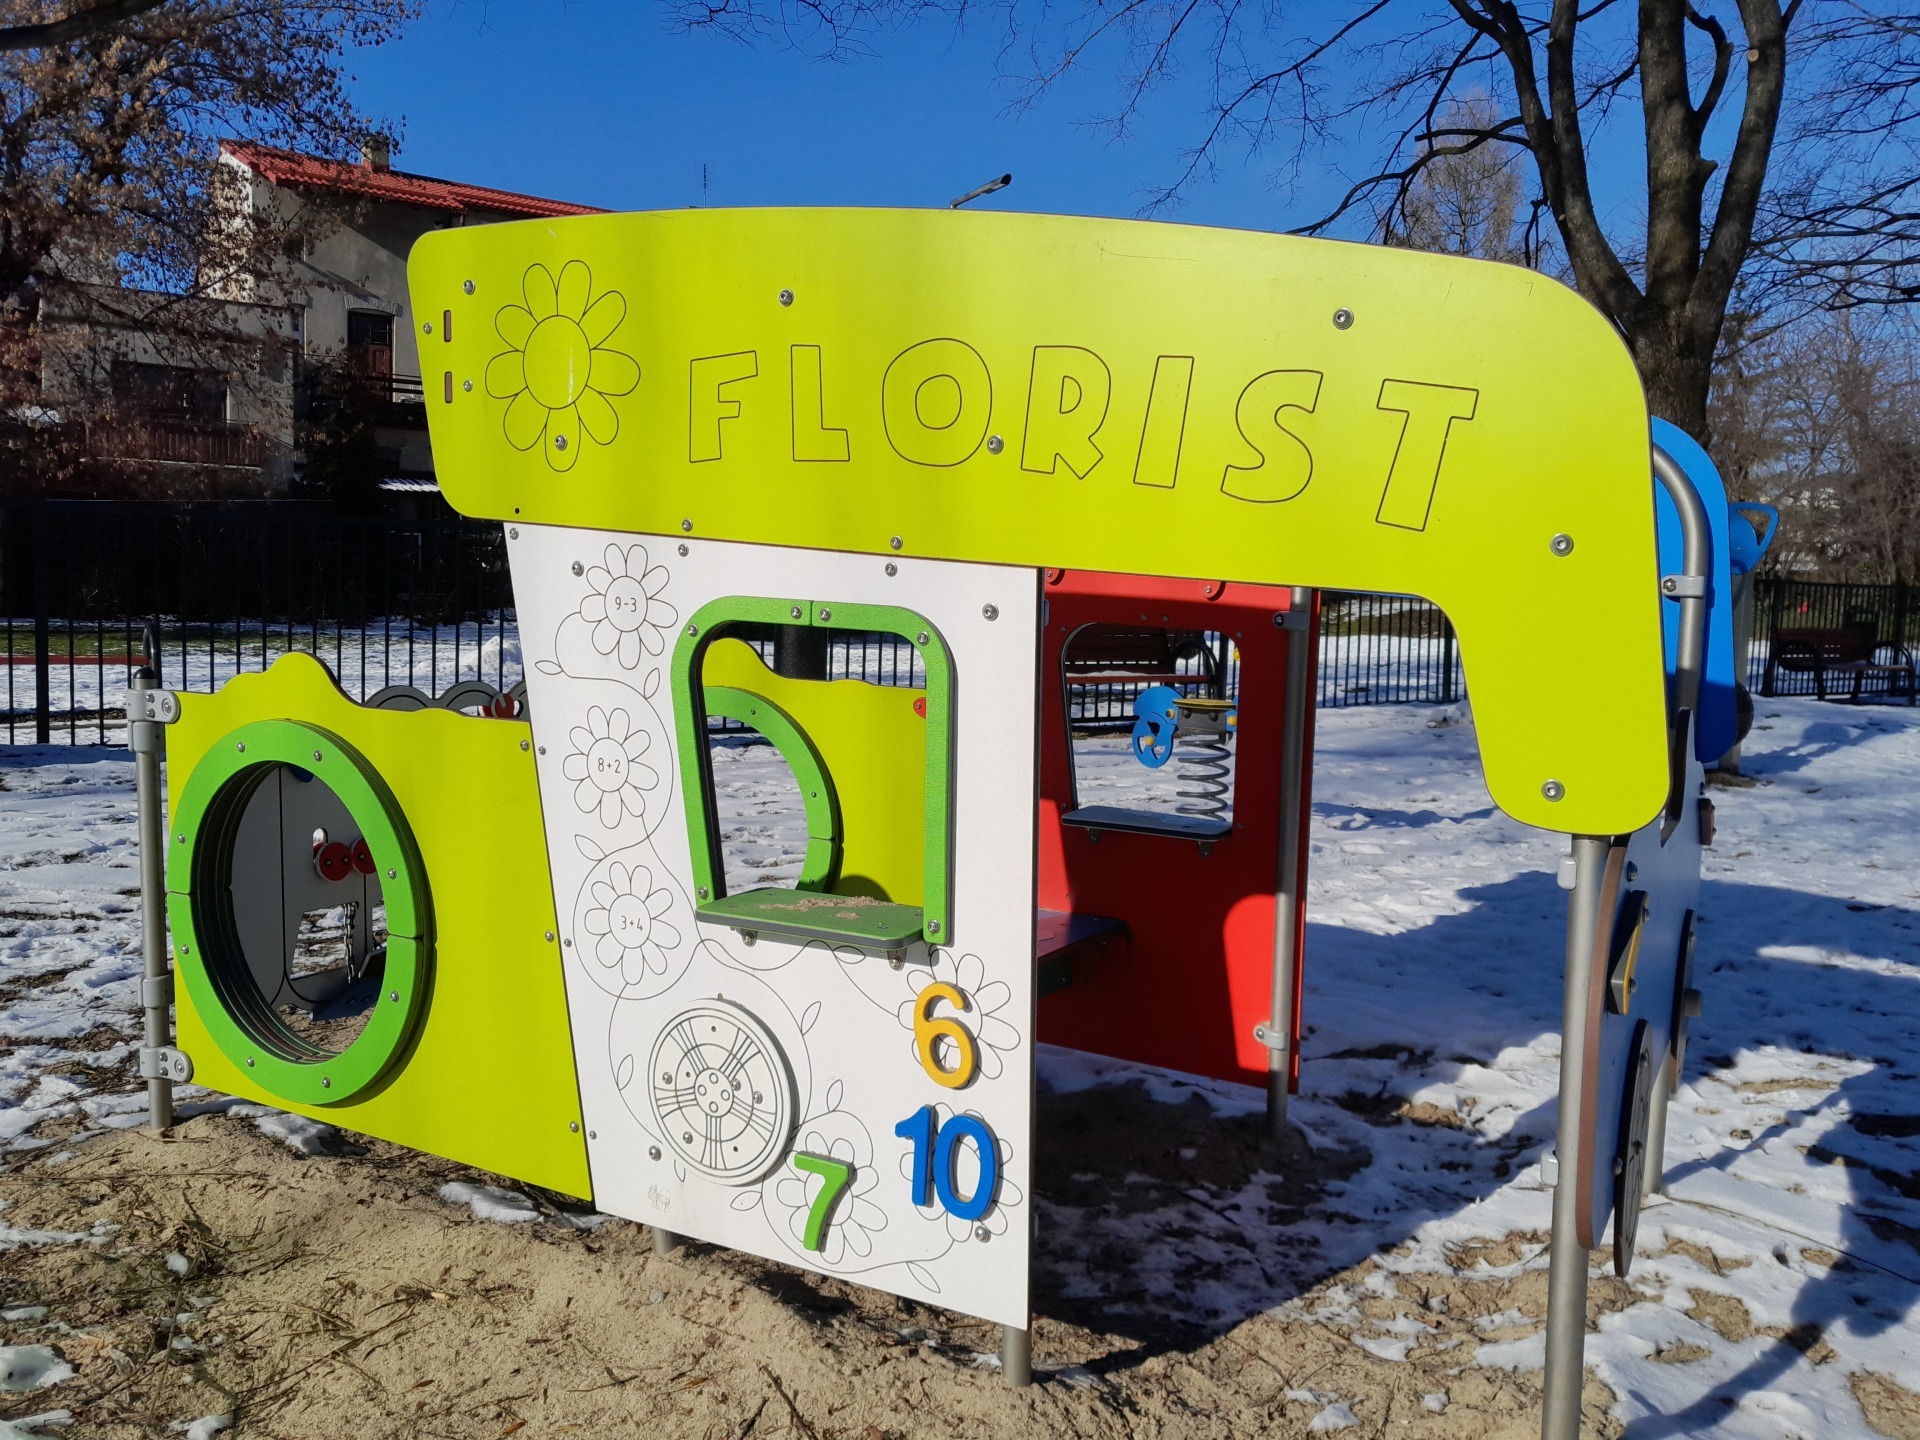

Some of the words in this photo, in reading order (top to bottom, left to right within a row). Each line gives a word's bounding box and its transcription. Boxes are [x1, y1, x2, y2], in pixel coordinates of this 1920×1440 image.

[689, 338, 1479, 532] FLORIST
[914, 981, 974, 1088] 6
[795, 1151, 850, 1250] 7
[895, 1105, 996, 1220] 10
